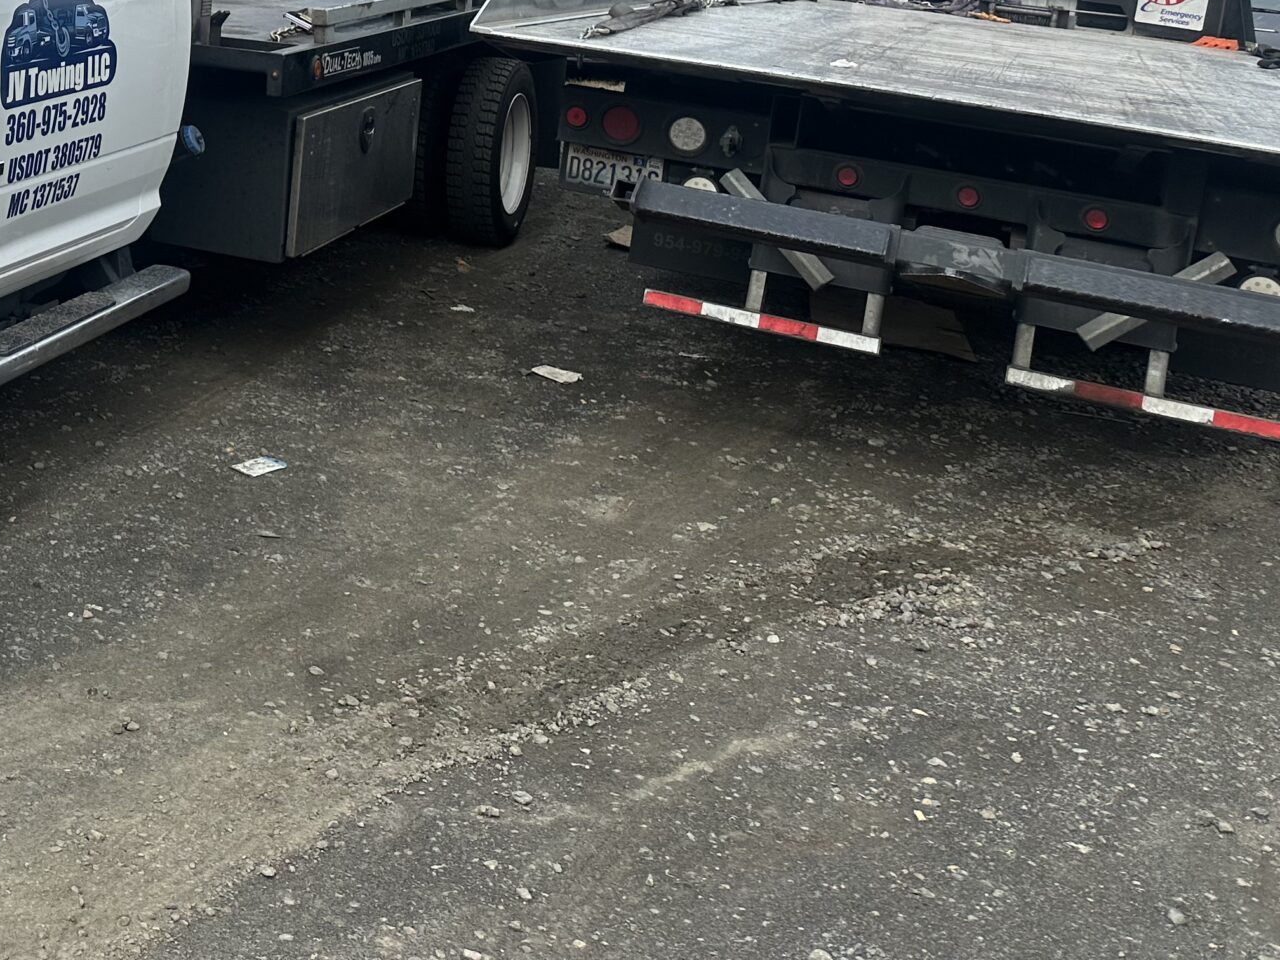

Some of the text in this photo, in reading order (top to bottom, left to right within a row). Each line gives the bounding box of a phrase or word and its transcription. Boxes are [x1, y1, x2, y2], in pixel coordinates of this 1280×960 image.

[1158, 16, 1190, 26] Services
[1160, 7, 1203, 22] Emergency
[6, 52, 110, 104] JV Towing LLC
[5, 92, 107, 146] 360-975-2928
[7, 133, 102, 184] USDOT 3805779
[572, 145, 628, 163] WASHINGTON
[6, 172, 81, 219] MC 1371537
